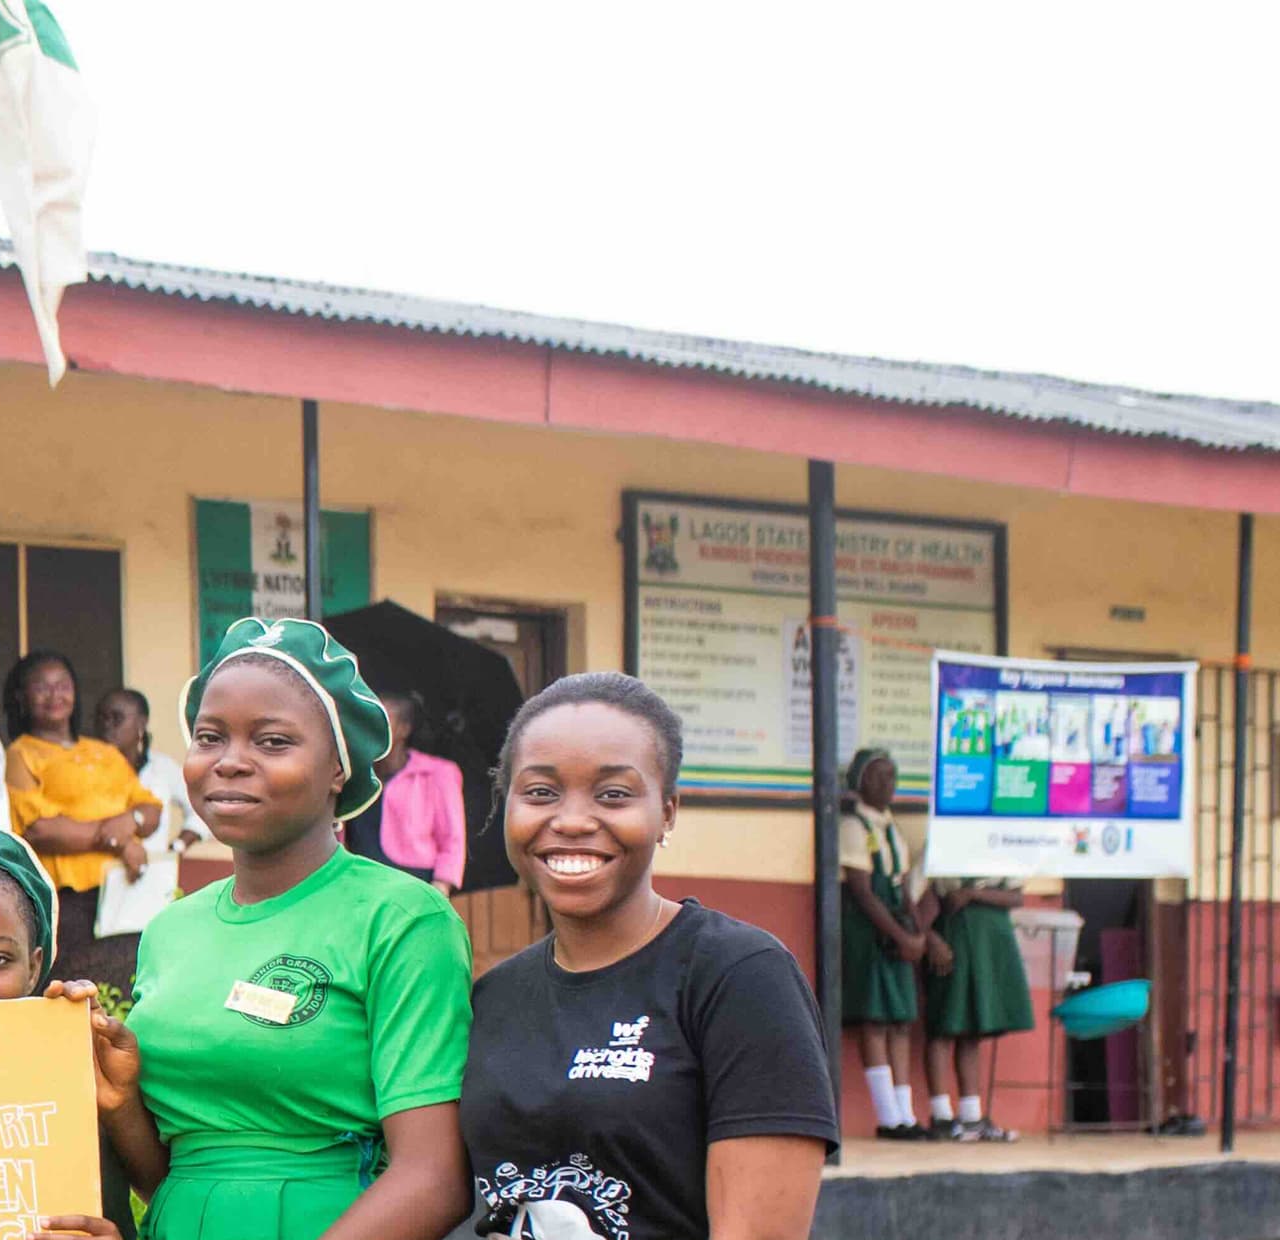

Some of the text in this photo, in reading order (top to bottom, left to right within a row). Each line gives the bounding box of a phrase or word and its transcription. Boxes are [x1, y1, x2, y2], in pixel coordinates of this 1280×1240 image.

[691, 519, 750, 544] LAGOS
[756, 524, 805, 547] STATE
[836, 530, 890, 553] NISTRY
